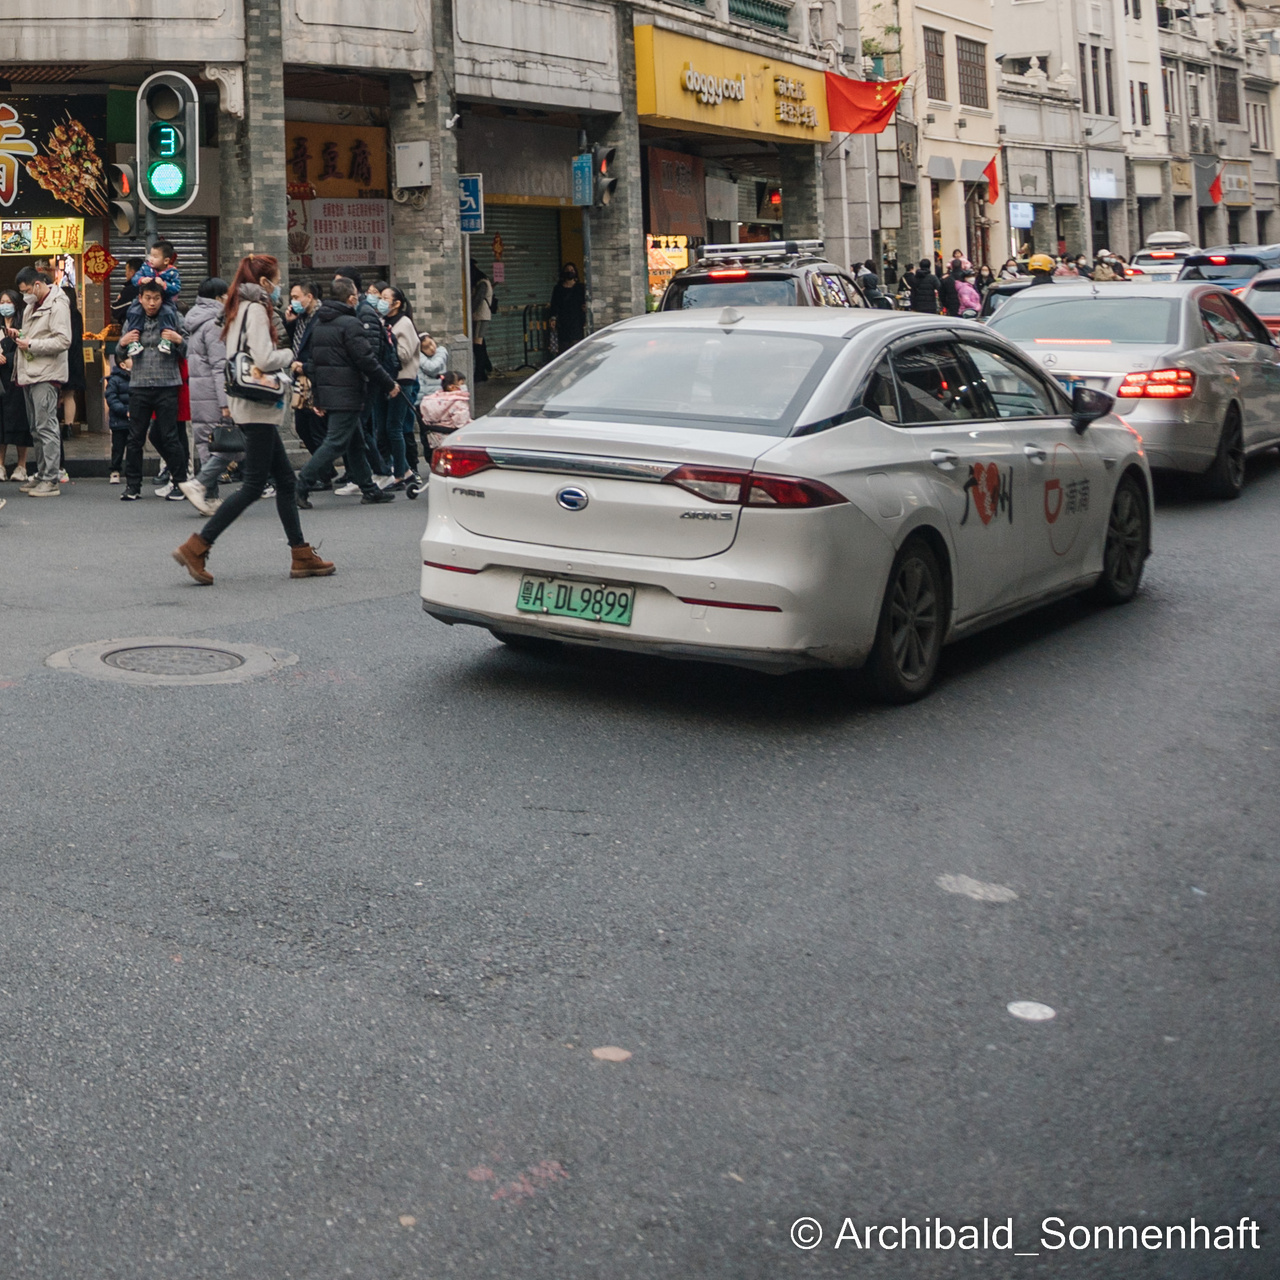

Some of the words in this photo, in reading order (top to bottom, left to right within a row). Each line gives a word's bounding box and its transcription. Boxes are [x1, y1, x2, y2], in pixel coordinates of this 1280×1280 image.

[160, 127, 175, 156] 3
[33, 224, 81, 250] 臭豆腐
[86, 251, 109, 274] 福
